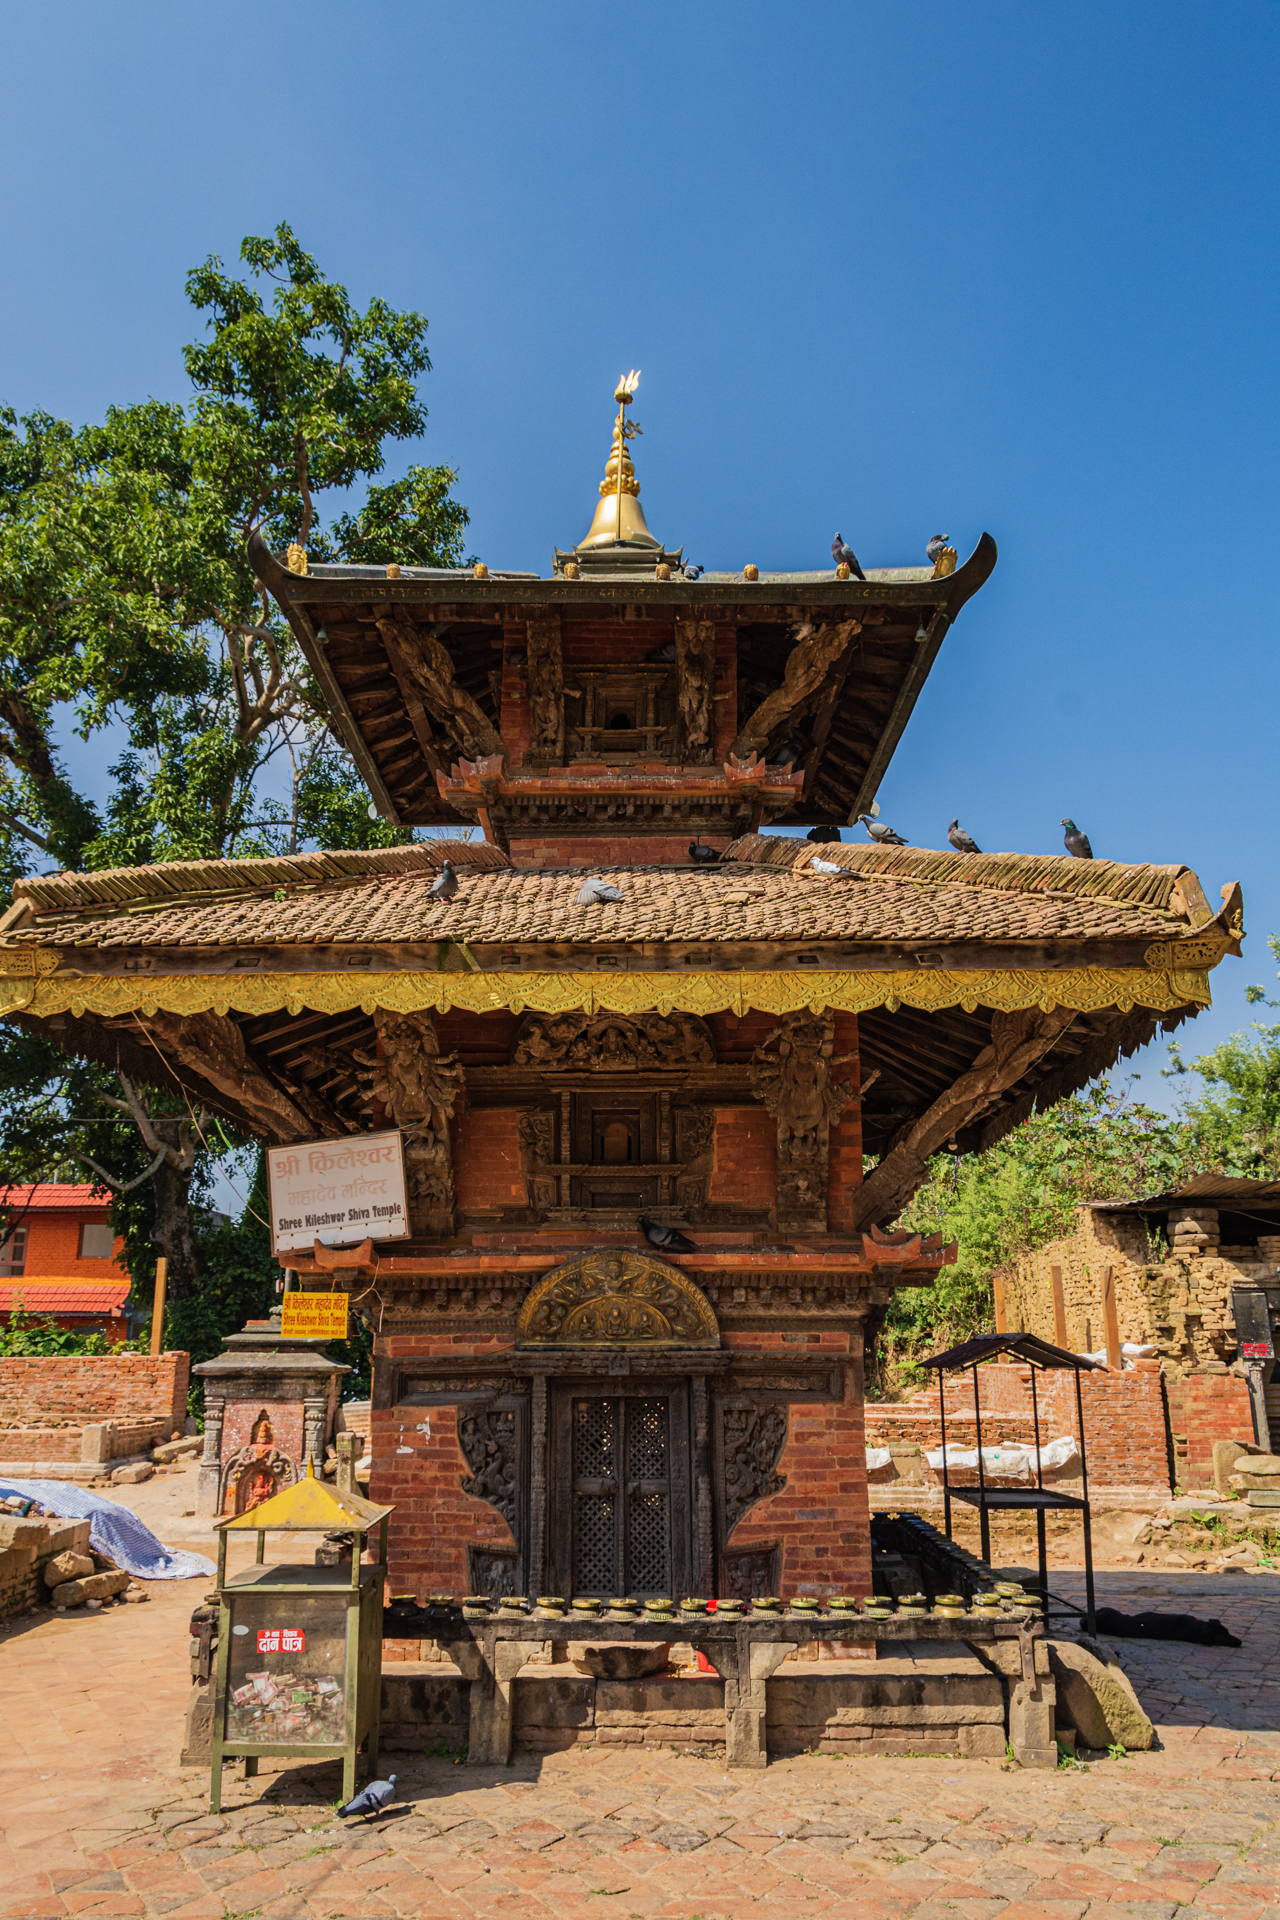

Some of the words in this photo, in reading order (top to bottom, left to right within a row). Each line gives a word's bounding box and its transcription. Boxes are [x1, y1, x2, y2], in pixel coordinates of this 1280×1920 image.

[275, 1155, 301, 1179] श्री
[308, 1146, 396, 1173] किलेश्वर
[288, 1183, 336, 1206] महादेव
[278, 1217, 302, 1231] Shree
[305, 1211, 345, 1227] Kileshwor
[348, 1207, 370, 1221] Shiva
[372, 1202, 402, 1218] Temple
[283, 1312, 296, 1326] Shree
[318, 1312, 330, 1326] Shiva
[330, 1312, 346, 1330] Temple
[259, 1638, 280, 1652] दान
[282, 1637, 303, 1652] पात्र
